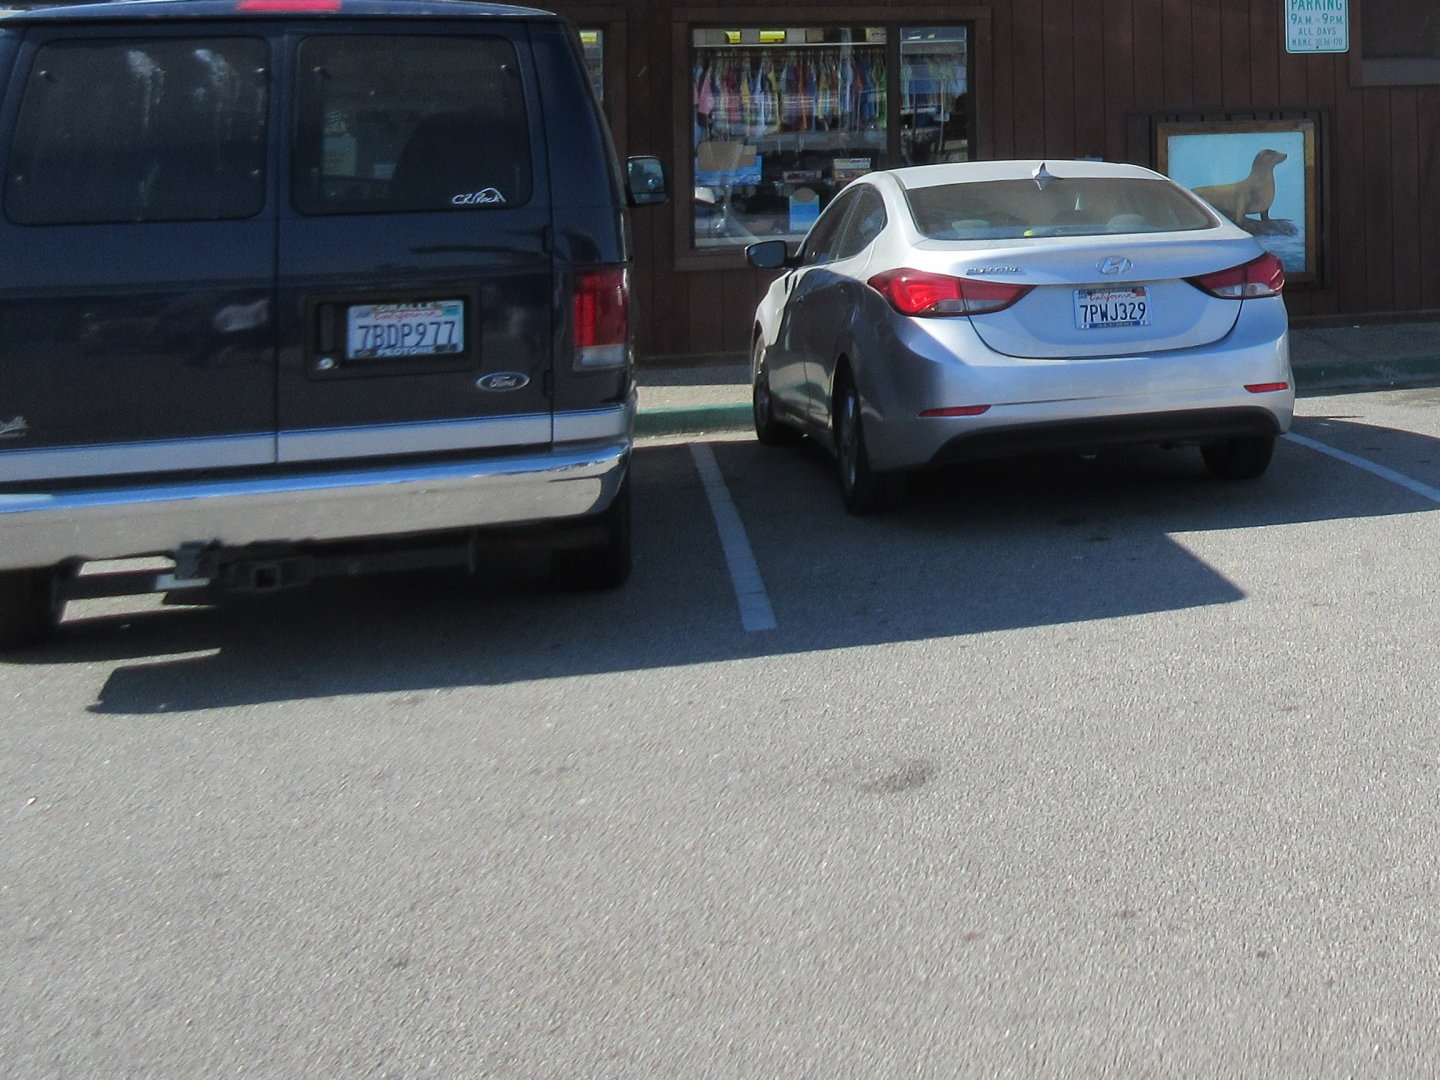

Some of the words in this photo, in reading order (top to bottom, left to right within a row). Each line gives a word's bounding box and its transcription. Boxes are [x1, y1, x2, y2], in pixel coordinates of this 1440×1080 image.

[1316, 27, 1337, 36] DAYS
[1079, 301, 1147, 323] 7PWJ329
[357, 320, 456, 351] 7BDP977
